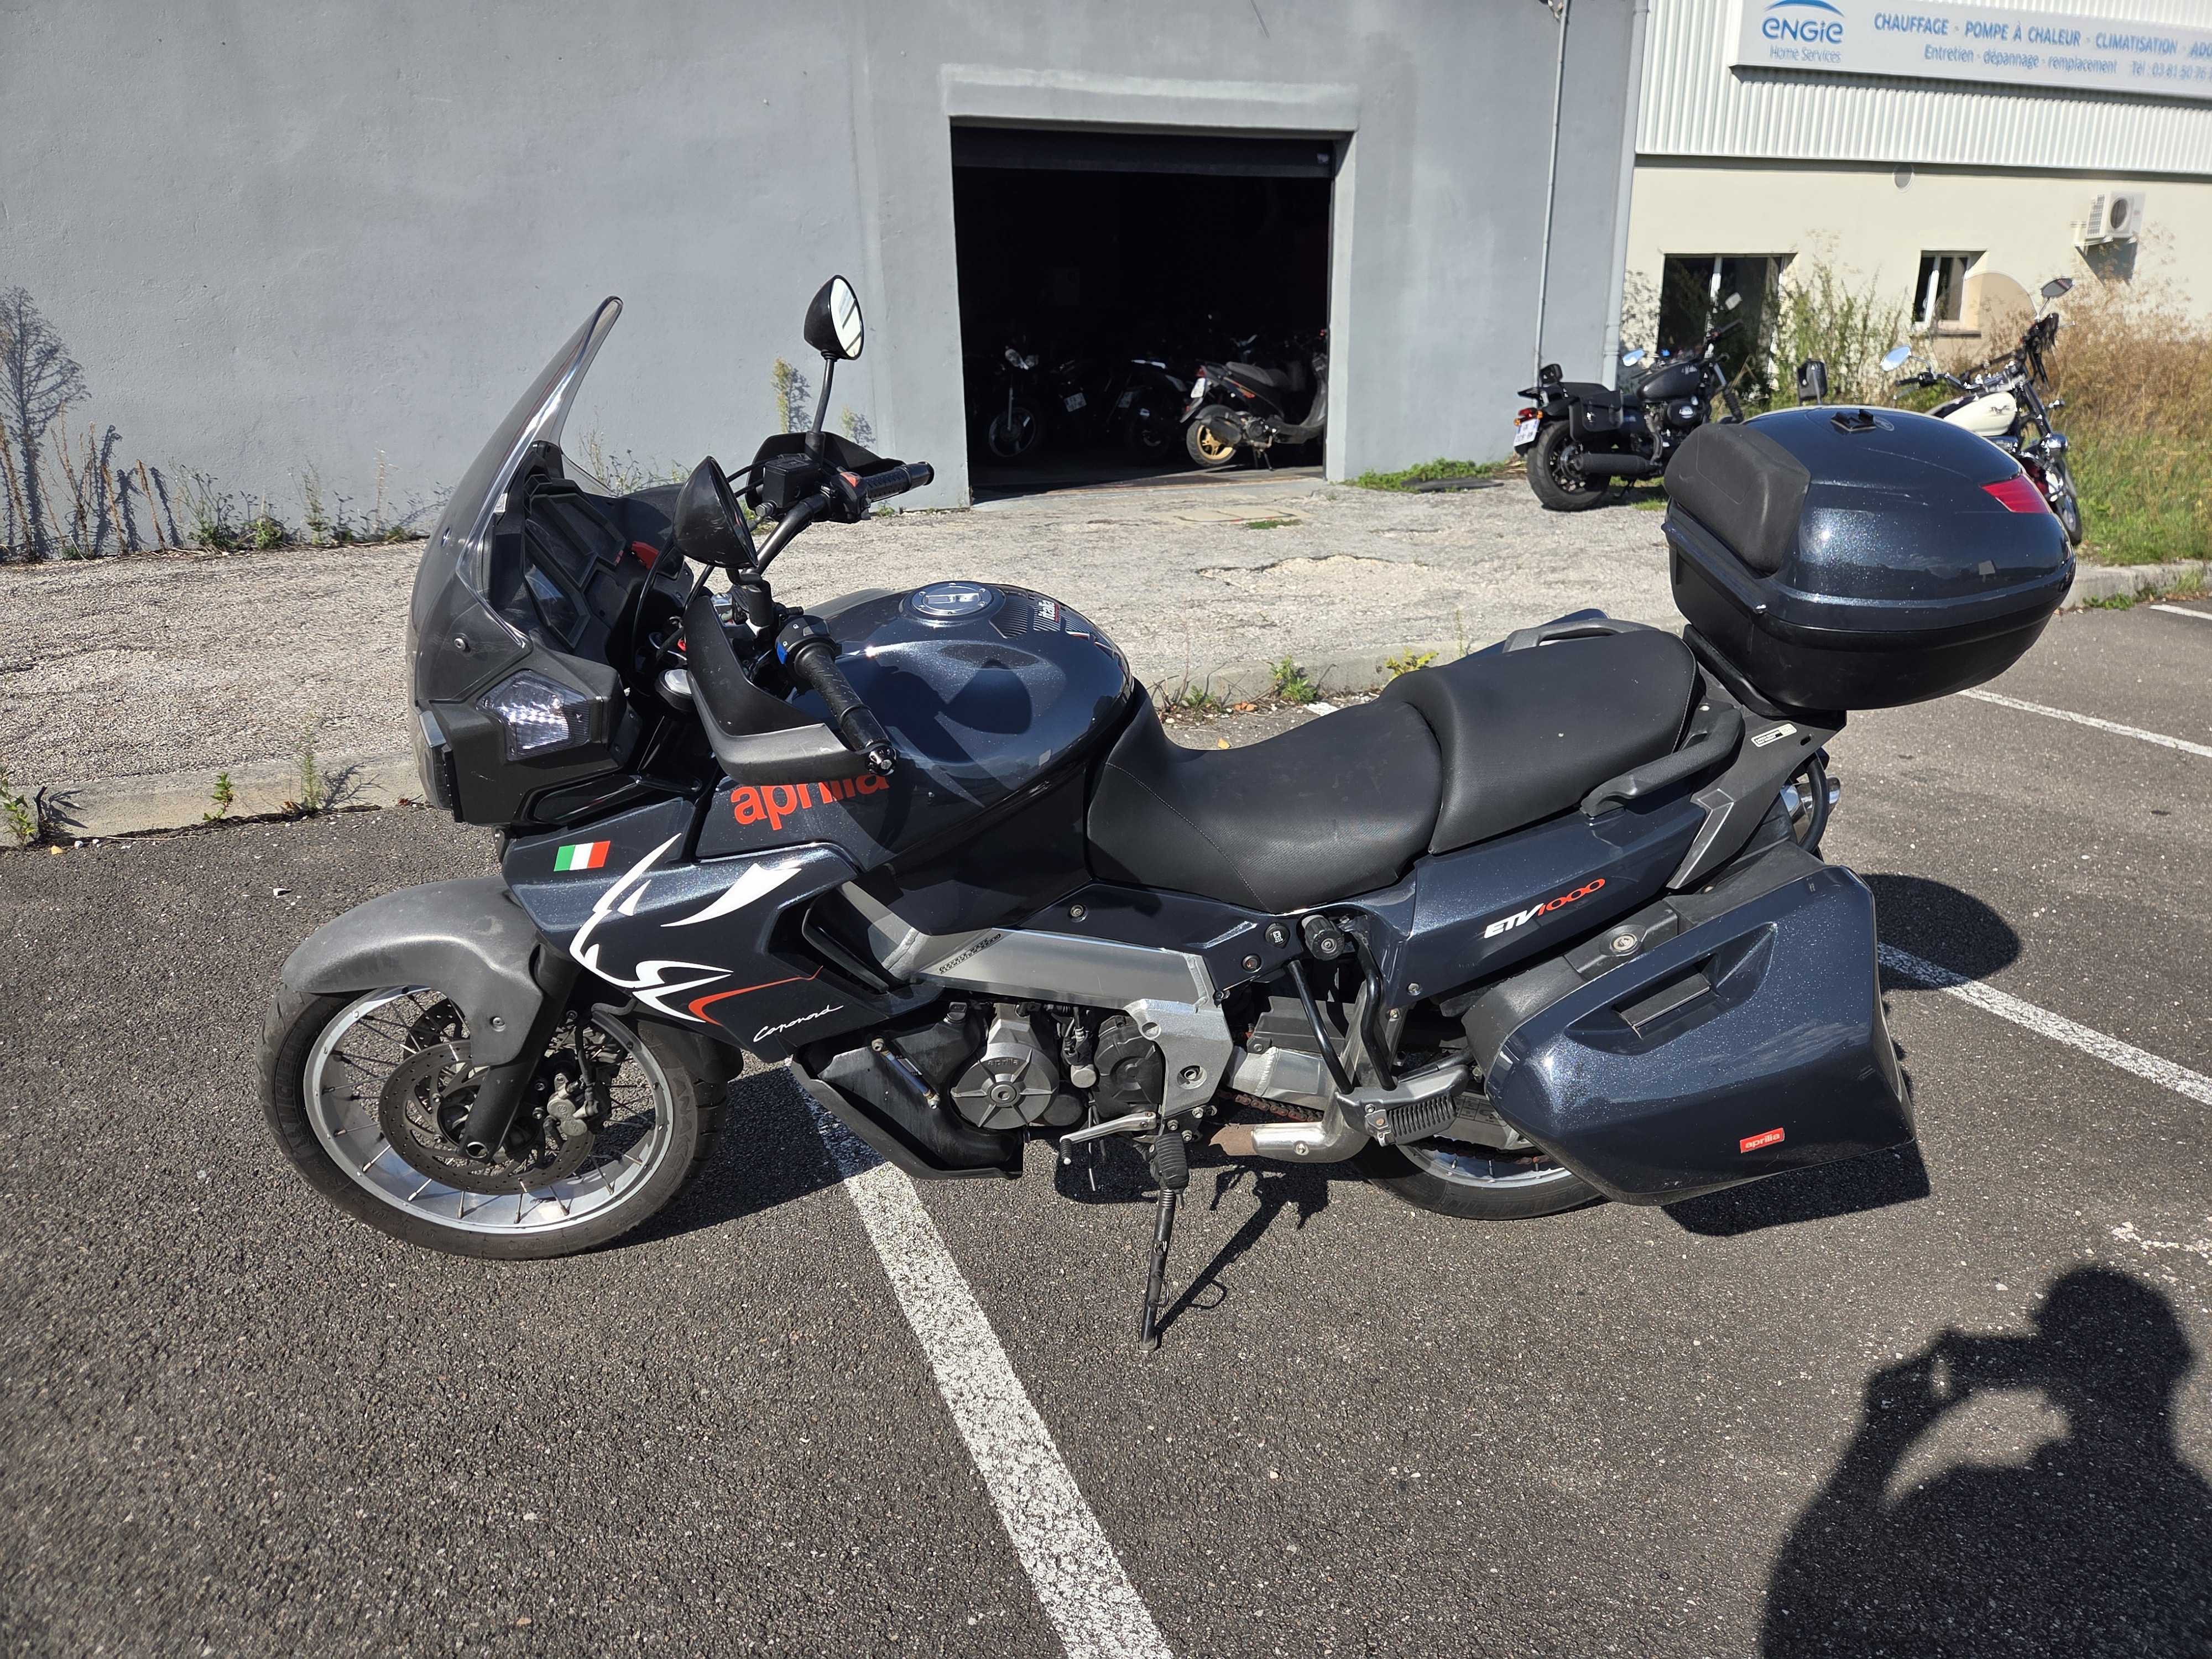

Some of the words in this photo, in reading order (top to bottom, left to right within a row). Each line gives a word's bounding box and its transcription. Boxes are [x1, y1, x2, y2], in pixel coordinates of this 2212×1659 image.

[1874, 12, 1949, 35] CHAUFFAGE
[1965, 20, 2009, 41] POMPE
[2012, 20, 2022, 42] À
[2028, 25, 2081, 46] CHALEUR
[2095, 32, 2178, 55] CLIMATISATION
[1770, 44, 1799, 61] Home
[1801, 46, 1842, 64] Services
[1924, 44, 1974, 62] Entretien
[1983, 48, 2039, 70] dépannage
[2048, 55, 2117, 74] remplacement
[1484, 879, 1605, 938] ETV1000
[753, 1004, 844, 1042] Caponord
[1745, 1133, 1780, 1148] aprilia
